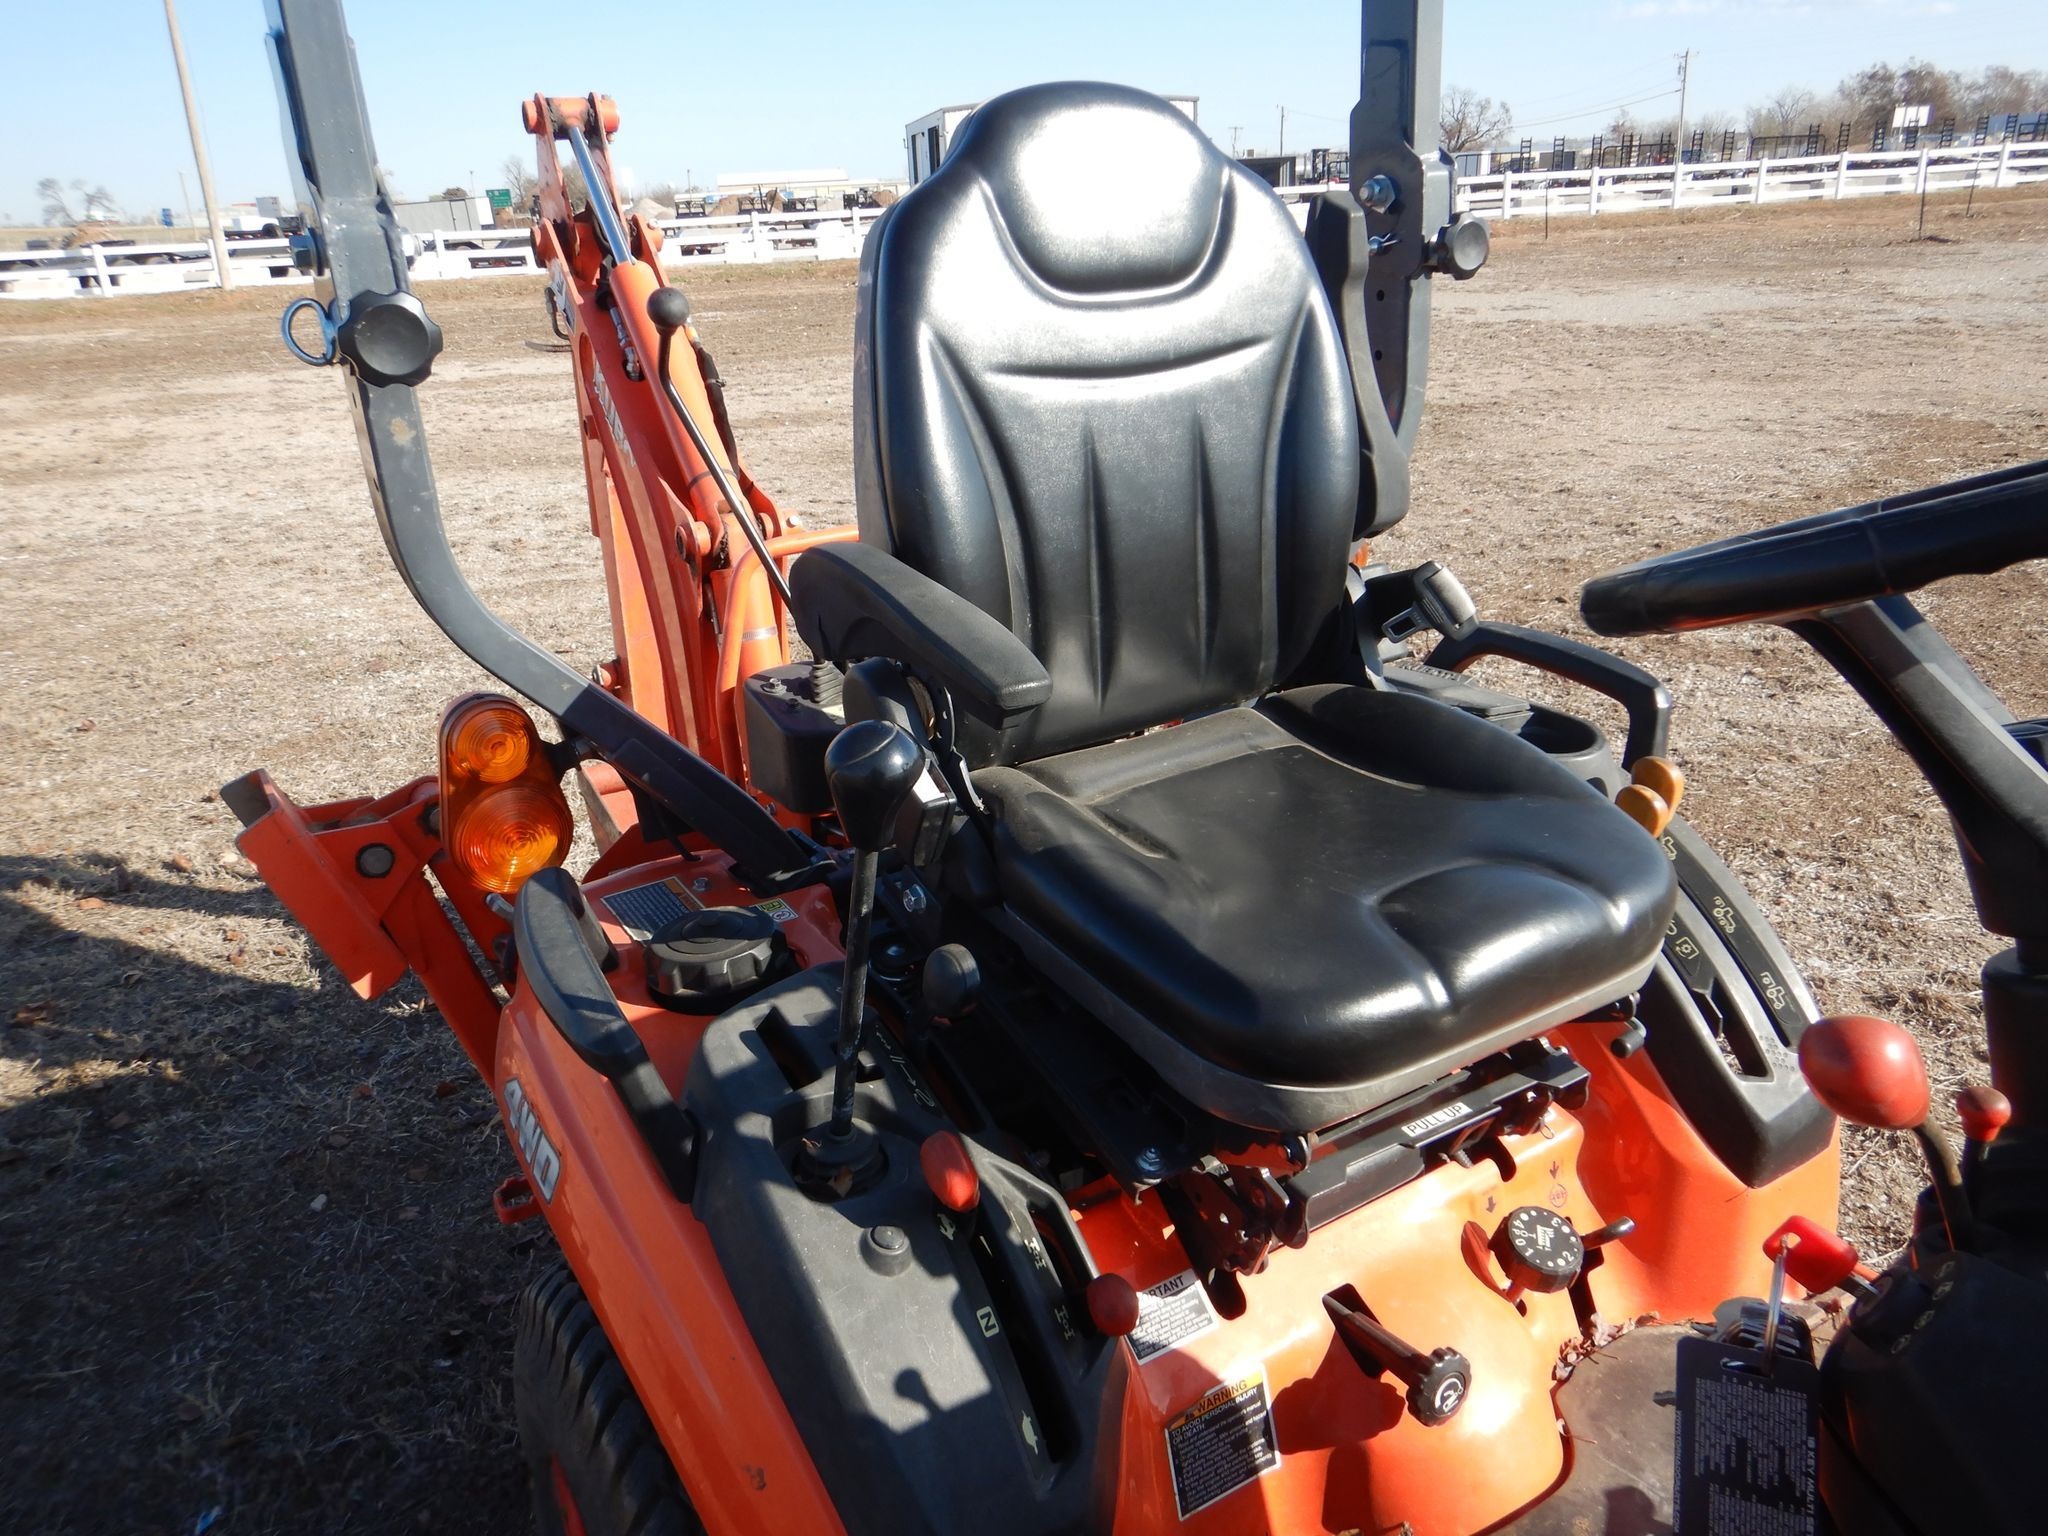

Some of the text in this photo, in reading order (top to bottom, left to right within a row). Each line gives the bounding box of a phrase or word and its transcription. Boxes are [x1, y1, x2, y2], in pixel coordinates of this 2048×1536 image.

[1407, 1105, 1462, 1134] PULL UP
[504, 1077, 561, 1204] 4WD
[1513, 1219, 1525, 1229] 4
[1551, 1217, 1561, 1227] 3
[1515, 1238, 1526, 1246] 0
[1525, 1248, 1534, 1256] 1
[1562, 1251, 1575, 1262] 2
[1147, 1275, 1185, 1296] RTANT
[979, 1311, 997, 1333] N
[1197, 1380, 1247, 1413] WARNING
[1171, 1387, 1257, 1437] TO AVOID PERSONAL INJURY
[1806, 1477, 1815, 1514] MULTI
